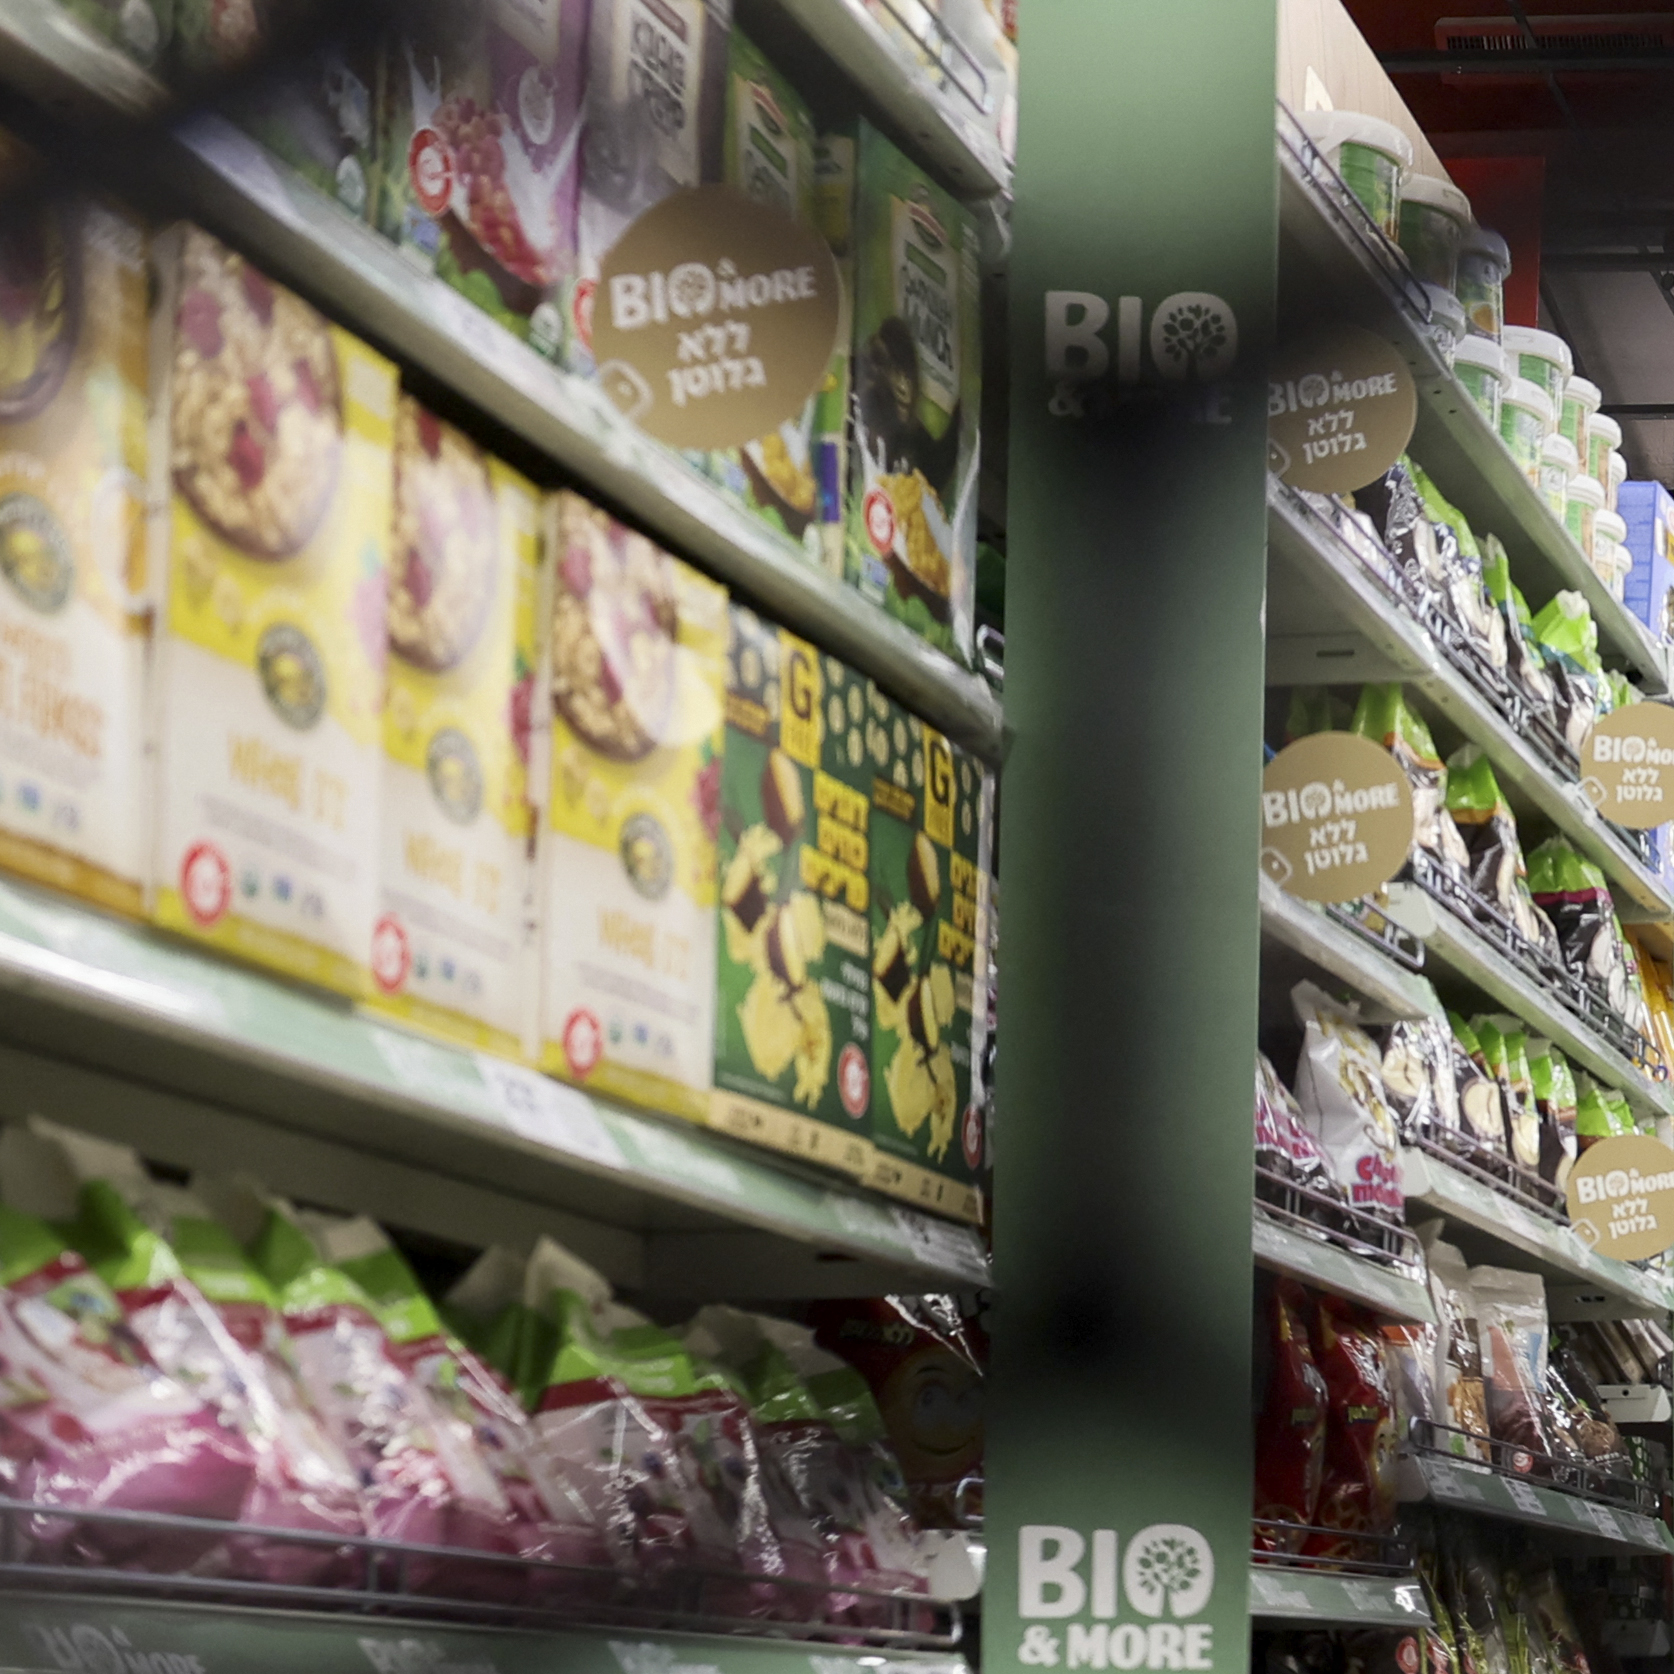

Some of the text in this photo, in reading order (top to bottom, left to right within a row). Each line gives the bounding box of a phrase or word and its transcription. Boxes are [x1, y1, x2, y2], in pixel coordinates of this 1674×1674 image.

[609, 262, 716, 330] BIO
[719, 265, 817, 312] MORE
[676, 319, 750, 362] ללא
[1044, 290, 1237, 386] BIO
[667, 356, 767, 407] גלוטן
[1332, 372, 1397, 403] MORE
[1308, 409, 1355, 436] ללא
[1302, 432, 1368, 464] גלוטן
[1594, 735, 1646, 762] BIO
[1621, 766, 1660, 784] ללא
[1262, 781, 1335, 828] BIO
[1335, 783, 1399, 815] MORE
[1616, 784, 1664, 802] גלוטן
[1309, 818, 1356, 847] ללא
[1303, 843, 1369, 876] גלוטן
[1577, 1169, 1629, 1204] BIO
[1611, 1198, 1648, 1219] ללא
[1608, 1214, 1658, 1240] גלוטן
[1018, 1523, 1215, 1619] BIO
[1018, 1623, 1214, 1671] & MORE
